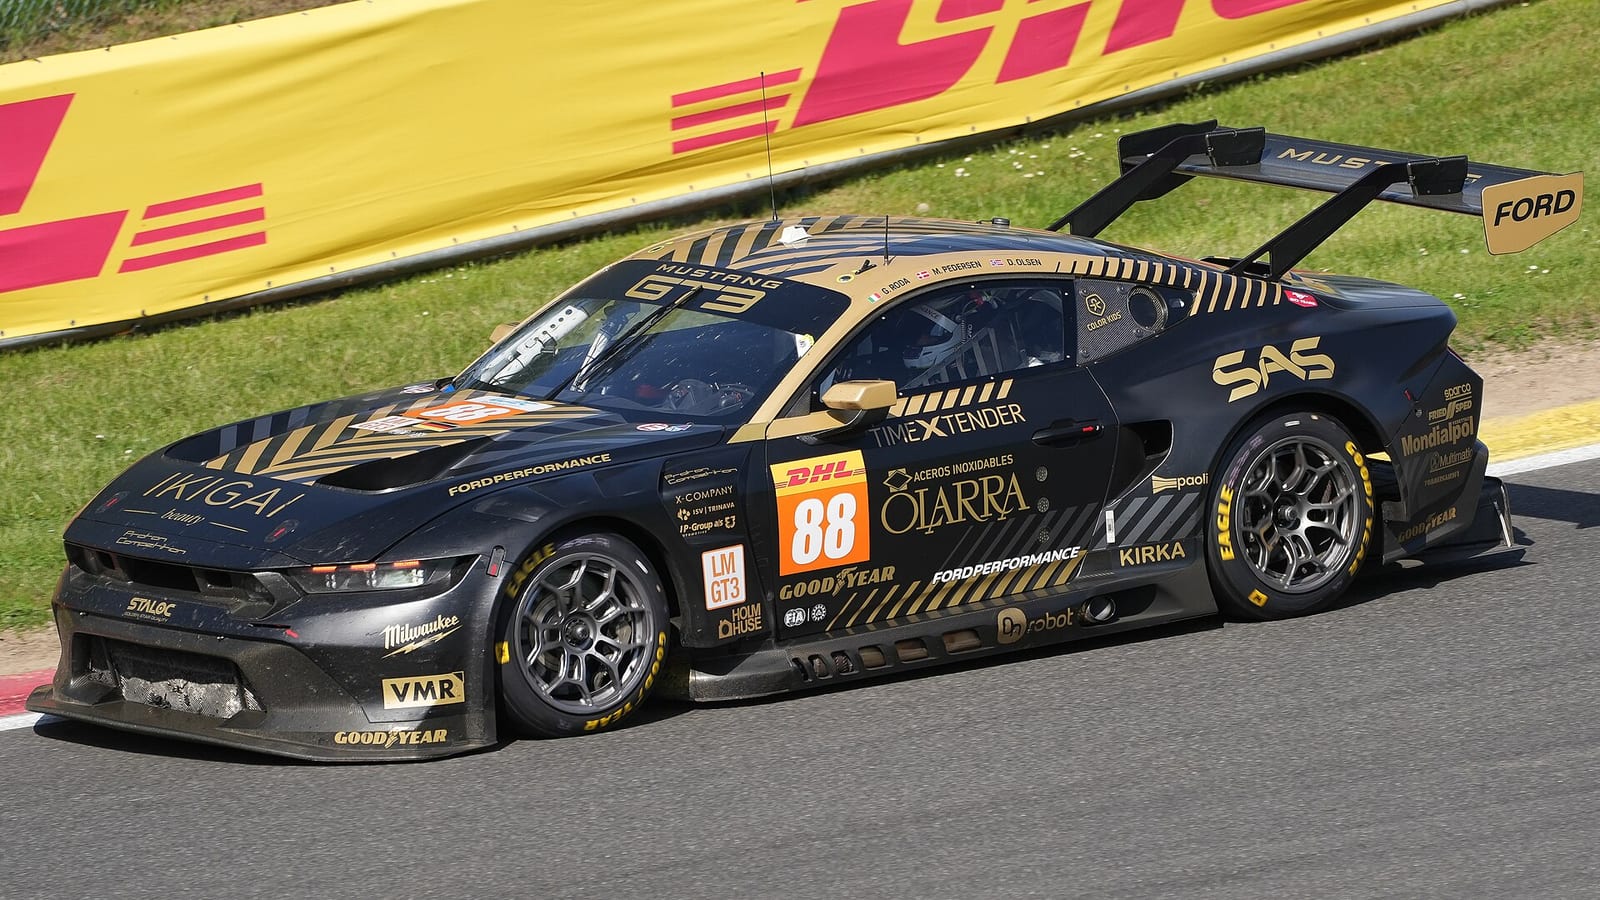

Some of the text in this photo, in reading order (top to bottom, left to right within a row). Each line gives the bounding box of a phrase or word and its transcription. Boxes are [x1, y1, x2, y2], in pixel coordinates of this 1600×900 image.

[1493, 189, 1576, 227] FORD
[943, 260, 982, 274] PEDERSEN
[1017, 257, 1042, 267] OLSEN
[655, 263, 784, 290] MUSTANG
[891, 278, 910, 292] RODA
[624, 274, 767, 314] GT3
[1087, 310, 1122, 332] COLOR KIDS
[1212, 336, 1336, 403] SAS
[1444, 383, 1471, 399] sparco
[1428, 407, 1447, 421] FRIED
[1455, 400, 1472, 413] SPED
[868, 403, 1026, 448] TIMEXTENDER
[1401, 416, 1474, 457] Mondialpol
[786, 460, 853, 487] DHL
[913, 454, 1014, 483] ACEROS INOXIDABLES
[675, 485, 733, 504] X-COMPANY
[1177, 473, 1209, 491] paoli
[143, 472, 305, 518] IKIGAI
[708, 501, 735, 513] TRINAVA
[881, 472, 1030, 534] OLARRA
[161, 508, 205, 526] beauty
[791, 492, 857, 565] 88
[1217, 484, 1235, 561] EAGLE
[711, 552, 736, 577] LM
[1120, 541, 1186, 567] KIRKA
[710, 577, 740, 603] GT3
[127, 597, 177, 617] STALOC
[732, 603, 761, 622] HOLM
[785, 609, 805, 625] FIA
[1028, 607, 1075, 632] robot
[380, 614, 460, 650] Milwaukee
[733, 616, 762, 636] HUSE
[390, 679, 455, 702] VMR
